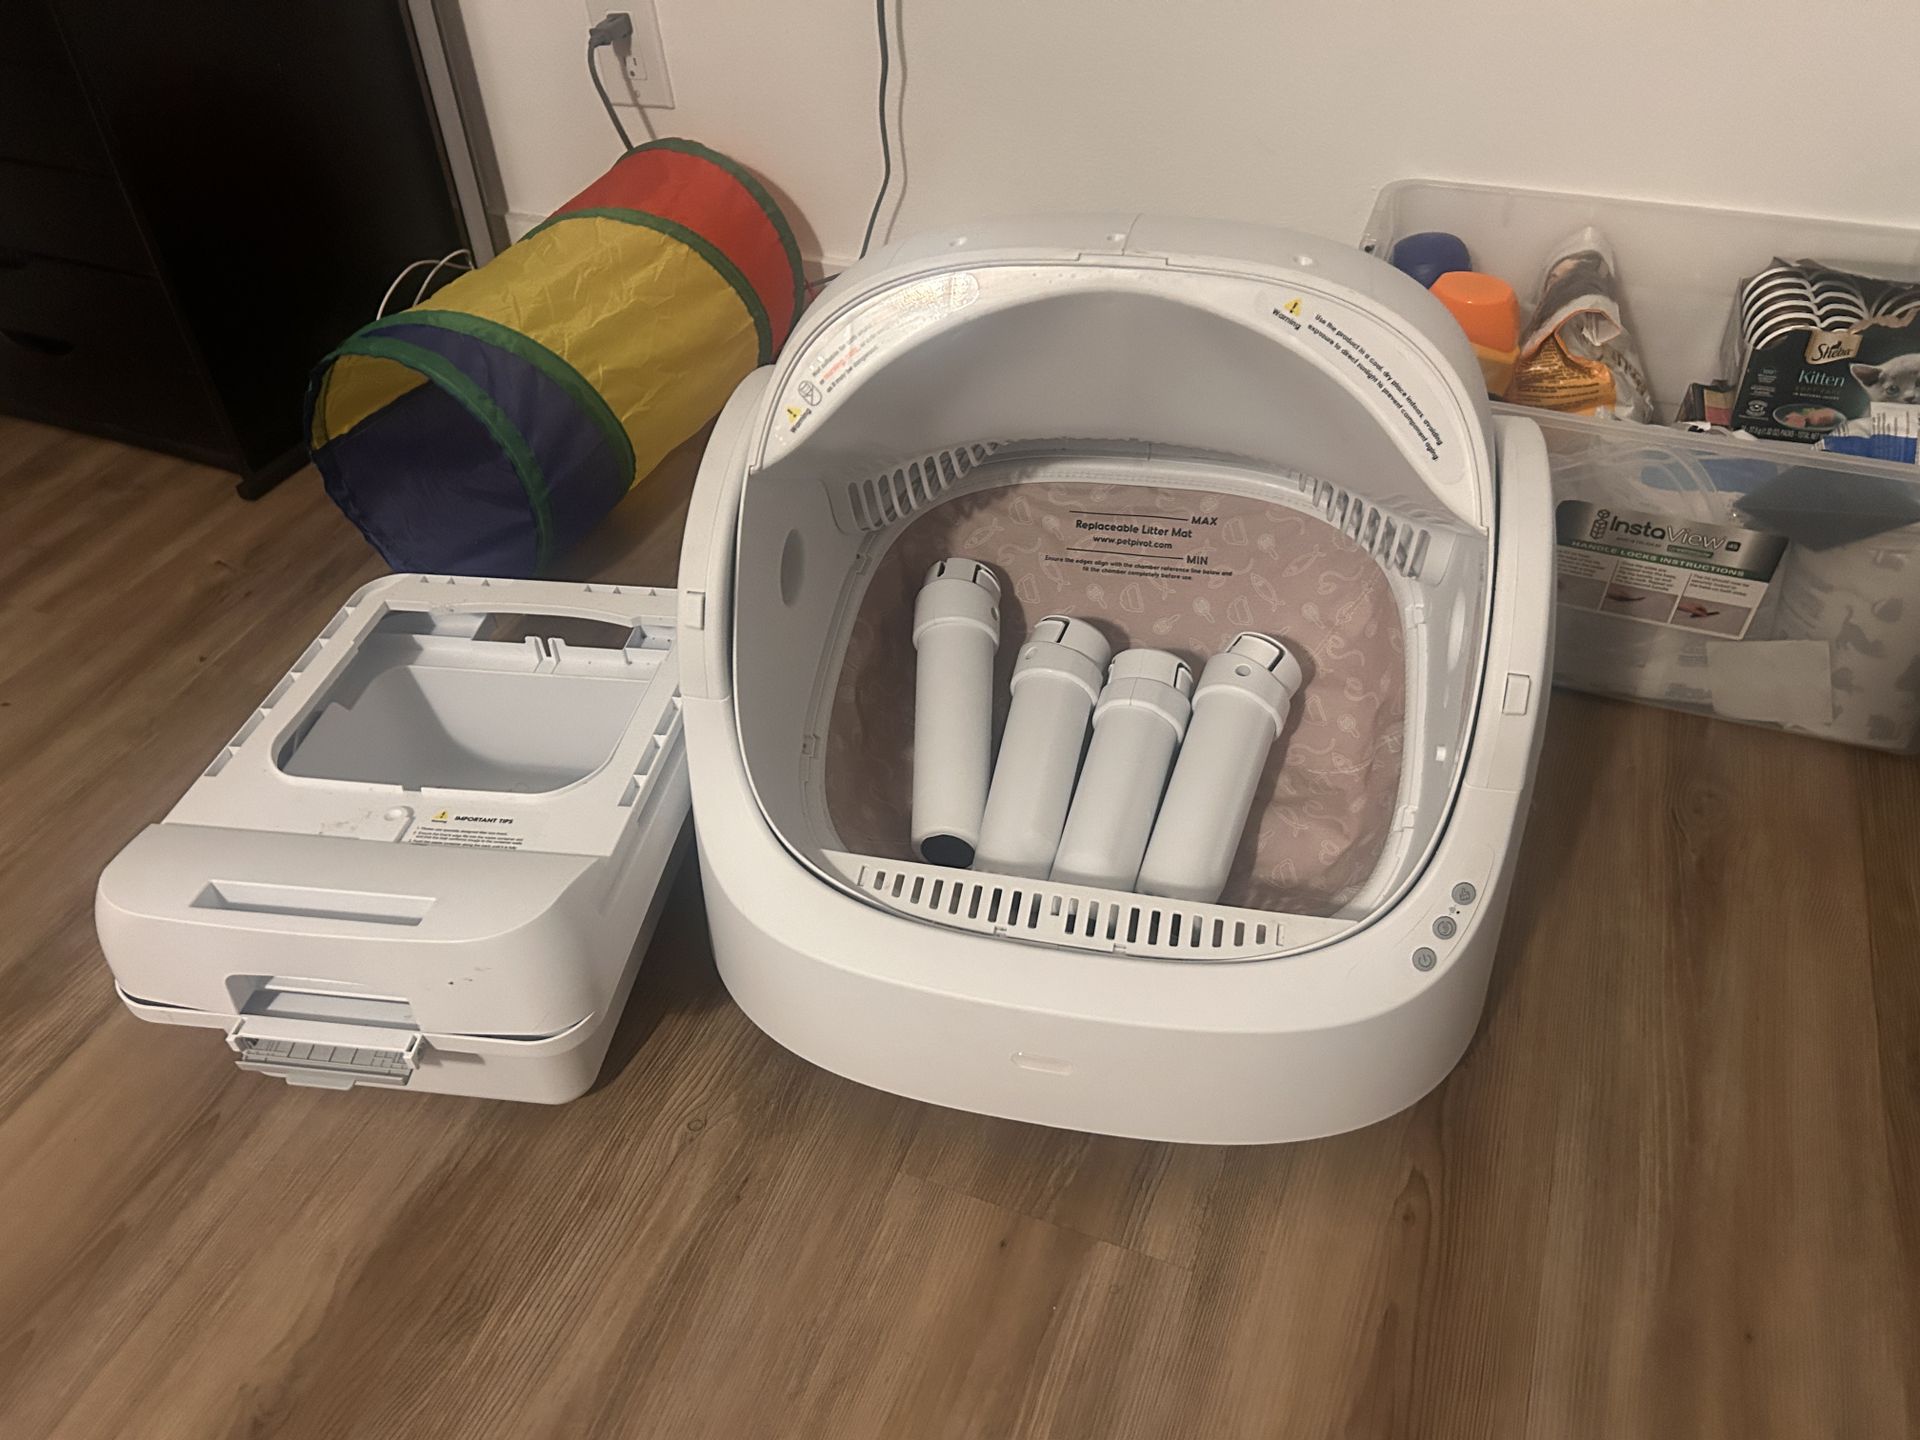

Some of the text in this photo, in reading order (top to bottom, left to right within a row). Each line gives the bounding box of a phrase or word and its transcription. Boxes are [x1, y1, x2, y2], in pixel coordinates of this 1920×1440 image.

[1272, 308, 1301, 330] Warning
[1308, 324, 1334, 345] exposure
[1334, 342, 1341, 350] to
[1341, 349, 1359, 364] direct
[1357, 363, 1378, 382] sunlight
[1377, 381, 1383, 389] to
[1382, 388, 1403, 409] prevent
[1401, 408, 1428, 442] component
[1314, 314, 1326, 324] Use
[1326, 322, 1337, 332] the
[1336, 330, 1360, 350] product
[1383, 371, 1392, 381] dry
[1391, 380, 1407, 397] place
[1423, 419, 1443, 446] avoiding
[1798, 369, 1845, 387] Kitten
[1075, 519, 1193, 539] Replaceable Litter Mat
[1191, 516, 1219, 526] MAX
[1609, 515, 1726, 551] InstaView
[1093, 535, 1173, 550] www.petpivot.com
[1045, 554, 1064, 562] Ensure
[1186, 555, 1209, 566] MIN
[1571, 541, 1618, 555] HANDLE
[1620, 548, 1657, 562] LOCKS
[1660, 556, 1745, 577] INSTRUCTIONS
[1128, 570, 1160, 579] completely
[454, 815, 498, 824] IMPORTANT
